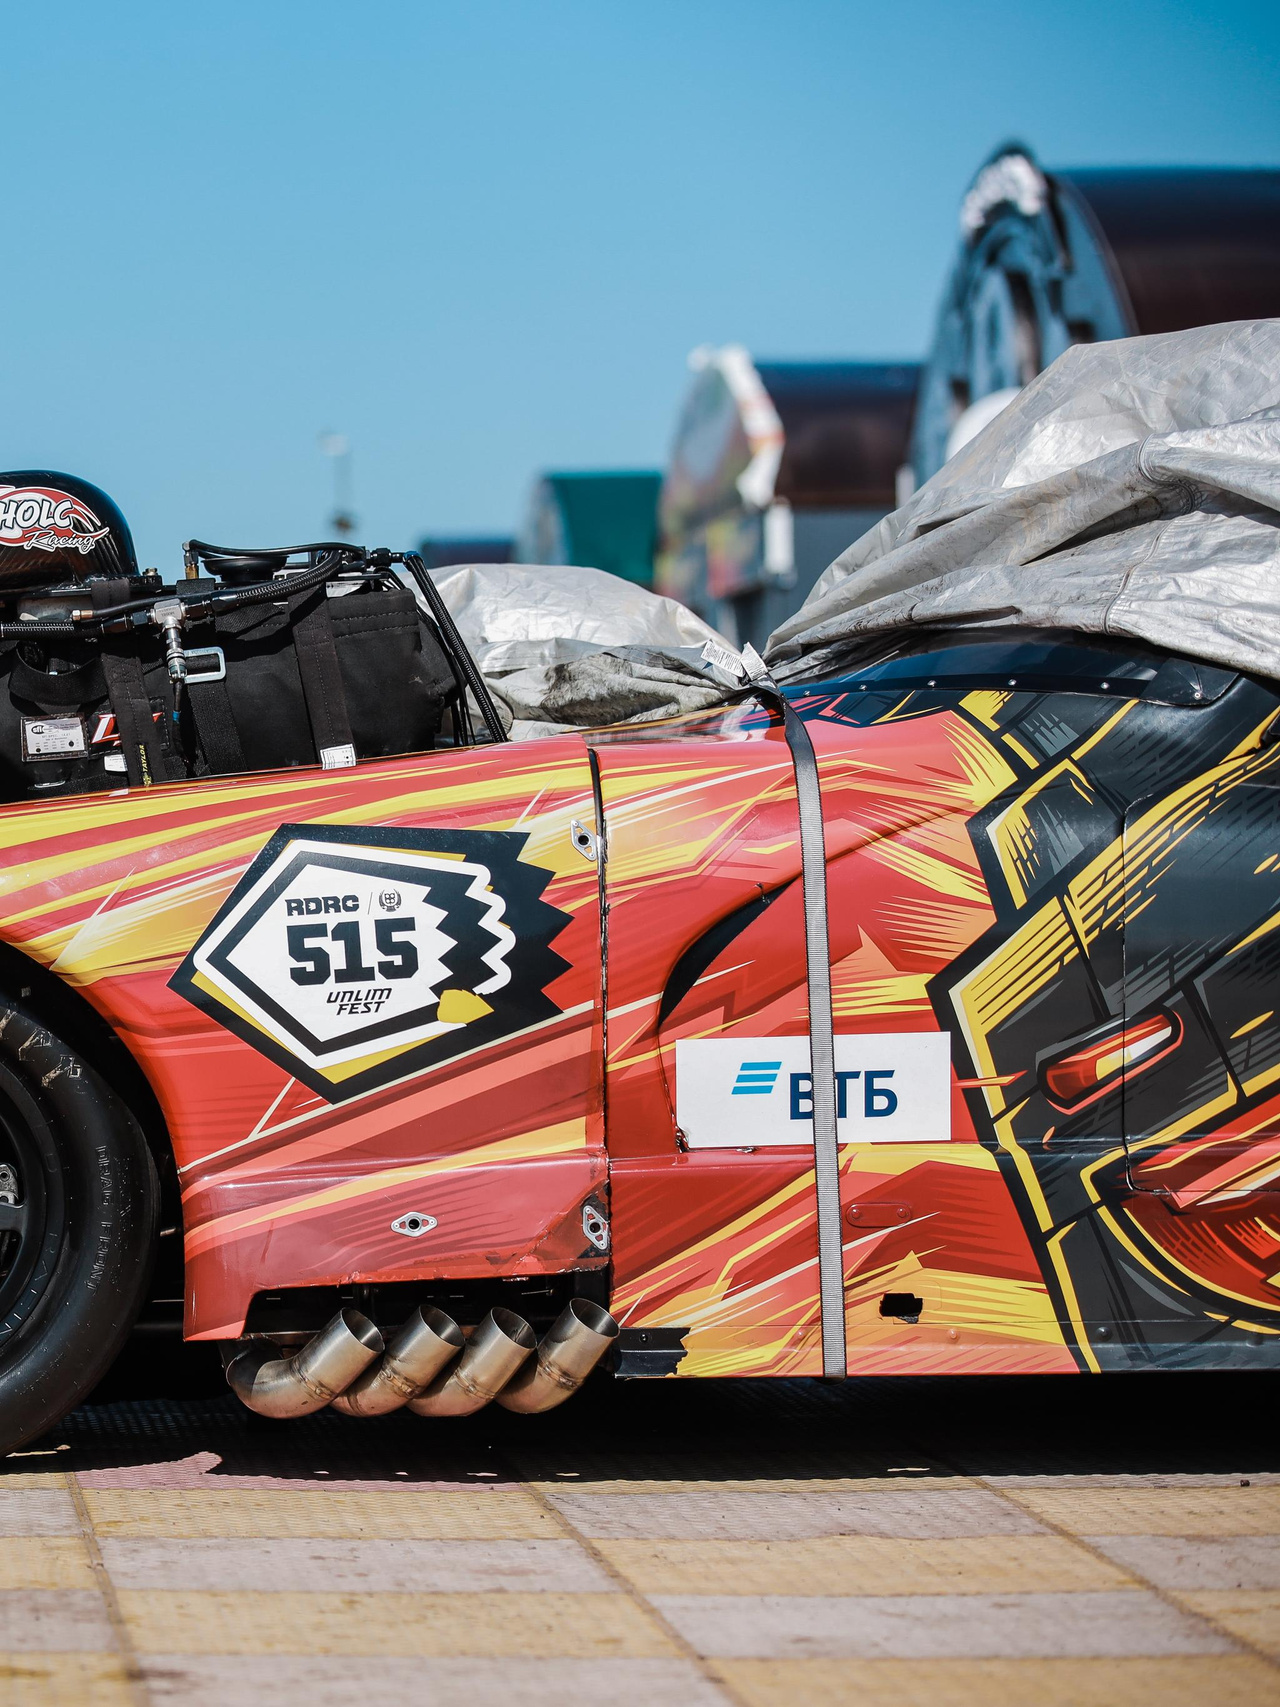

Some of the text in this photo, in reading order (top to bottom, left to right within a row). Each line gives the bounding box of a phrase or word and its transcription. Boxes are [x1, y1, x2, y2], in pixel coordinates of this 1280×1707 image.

[24, 530, 95, 554] Racing
[138, 744, 149, 772] TAYLOR
[285, 895, 359, 916] RDRC
[286, 917, 419, 986] 515
[327, 988, 392, 1004] UNLIM
[336, 1001, 385, 1015] FEST
[789, 1070, 898, 1120] ВТБ
[84, 1145, 113, 1296] DRAG FRONT
